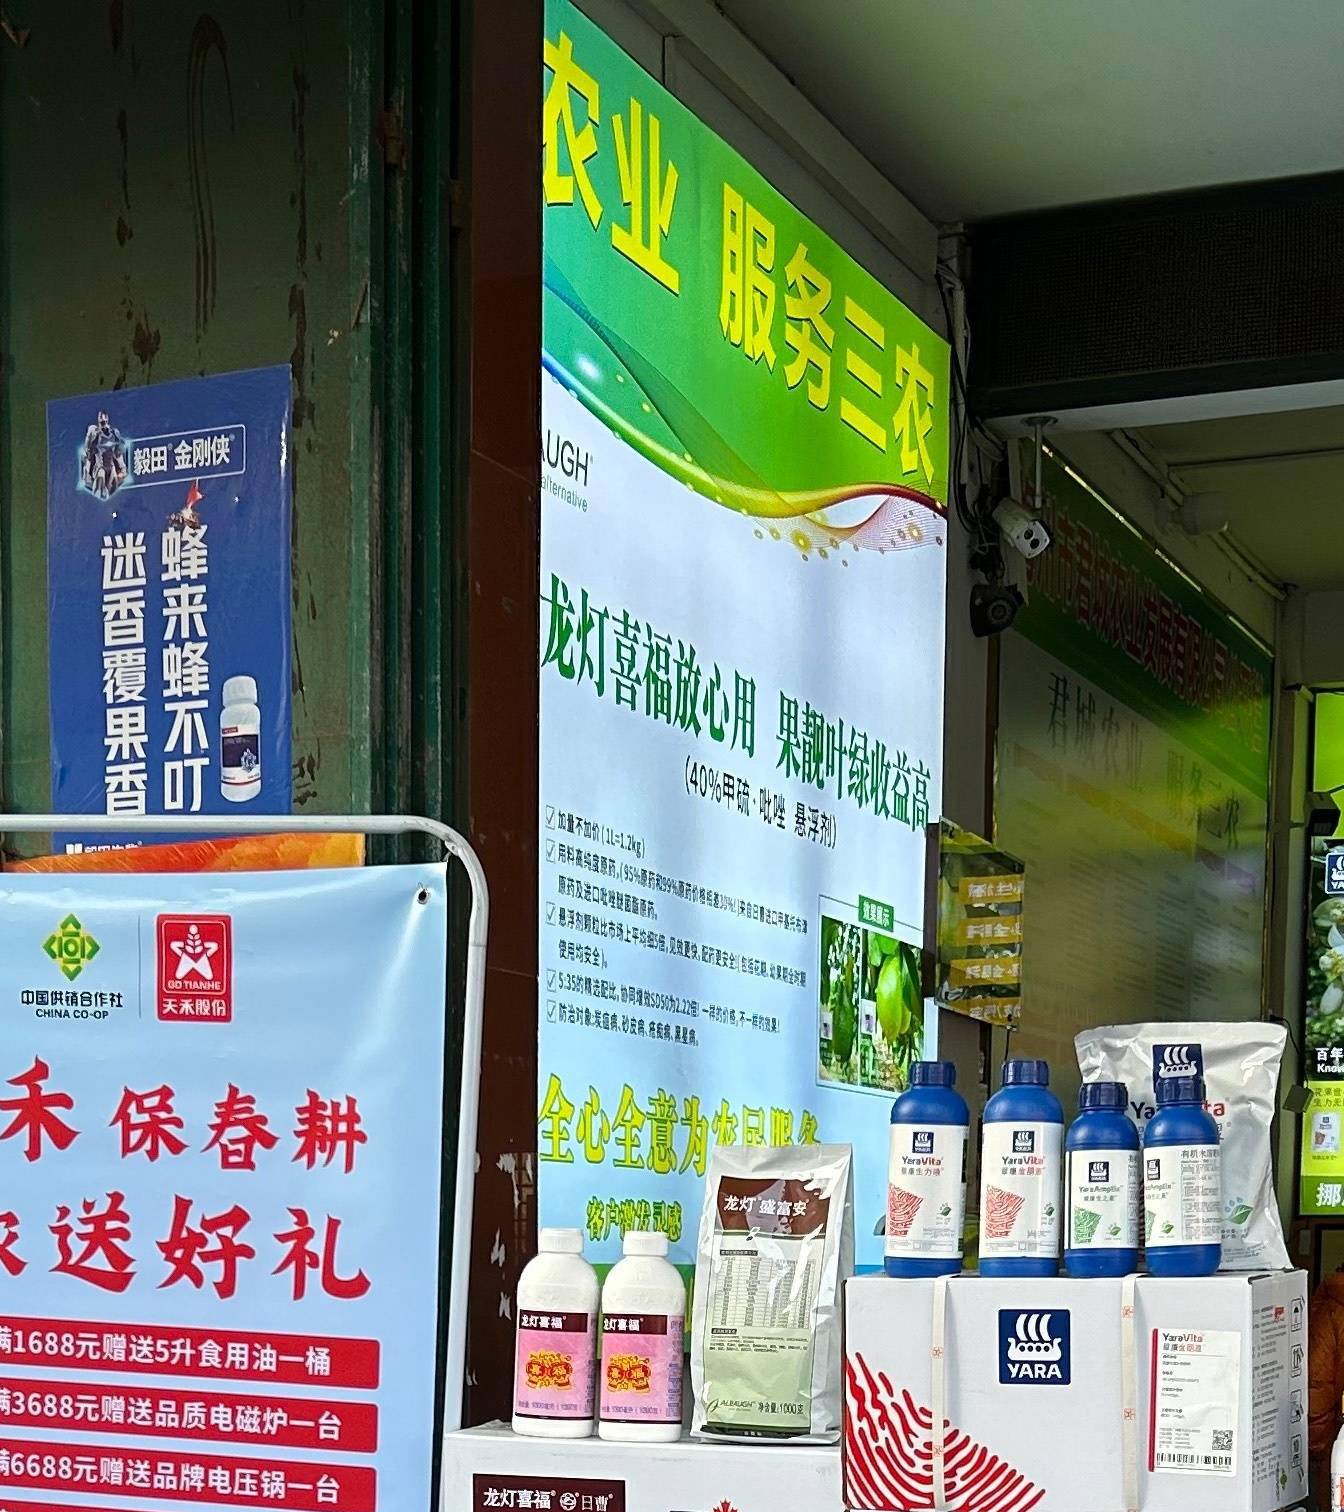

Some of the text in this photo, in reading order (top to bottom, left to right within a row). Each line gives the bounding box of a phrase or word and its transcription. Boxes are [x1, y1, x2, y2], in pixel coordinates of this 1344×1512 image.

[719, 181, 934, 485] 服务三农
[174, 437, 231, 470] 金刚侠
[101, 532, 148, 816] 迷香覆果香
[161, 525, 210, 813] 蜂来蜂不叮
[541, 572, 932, 831] 龙灯喜福放心用 果靓叶绿收益高
[185, 980, 222, 991] TIANHE
[21, 990, 123, 1009] 中国供销合作社
[161, 998, 227, 1018] 天禾股份
[35, 1008, 109, 1020] CHINA CO-OP
[901, 1156, 942, 1167] YaraVita
[1001, 1155, 1043, 1166] YaraVita
[723, 1193, 809, 1218] 龙灯 盛富安
[1162, 1332, 1204, 1343] YaraVita
[1007, 1362, 1062, 1379] YARA
[483, 1487, 551, 1511] 龙灯喜福
